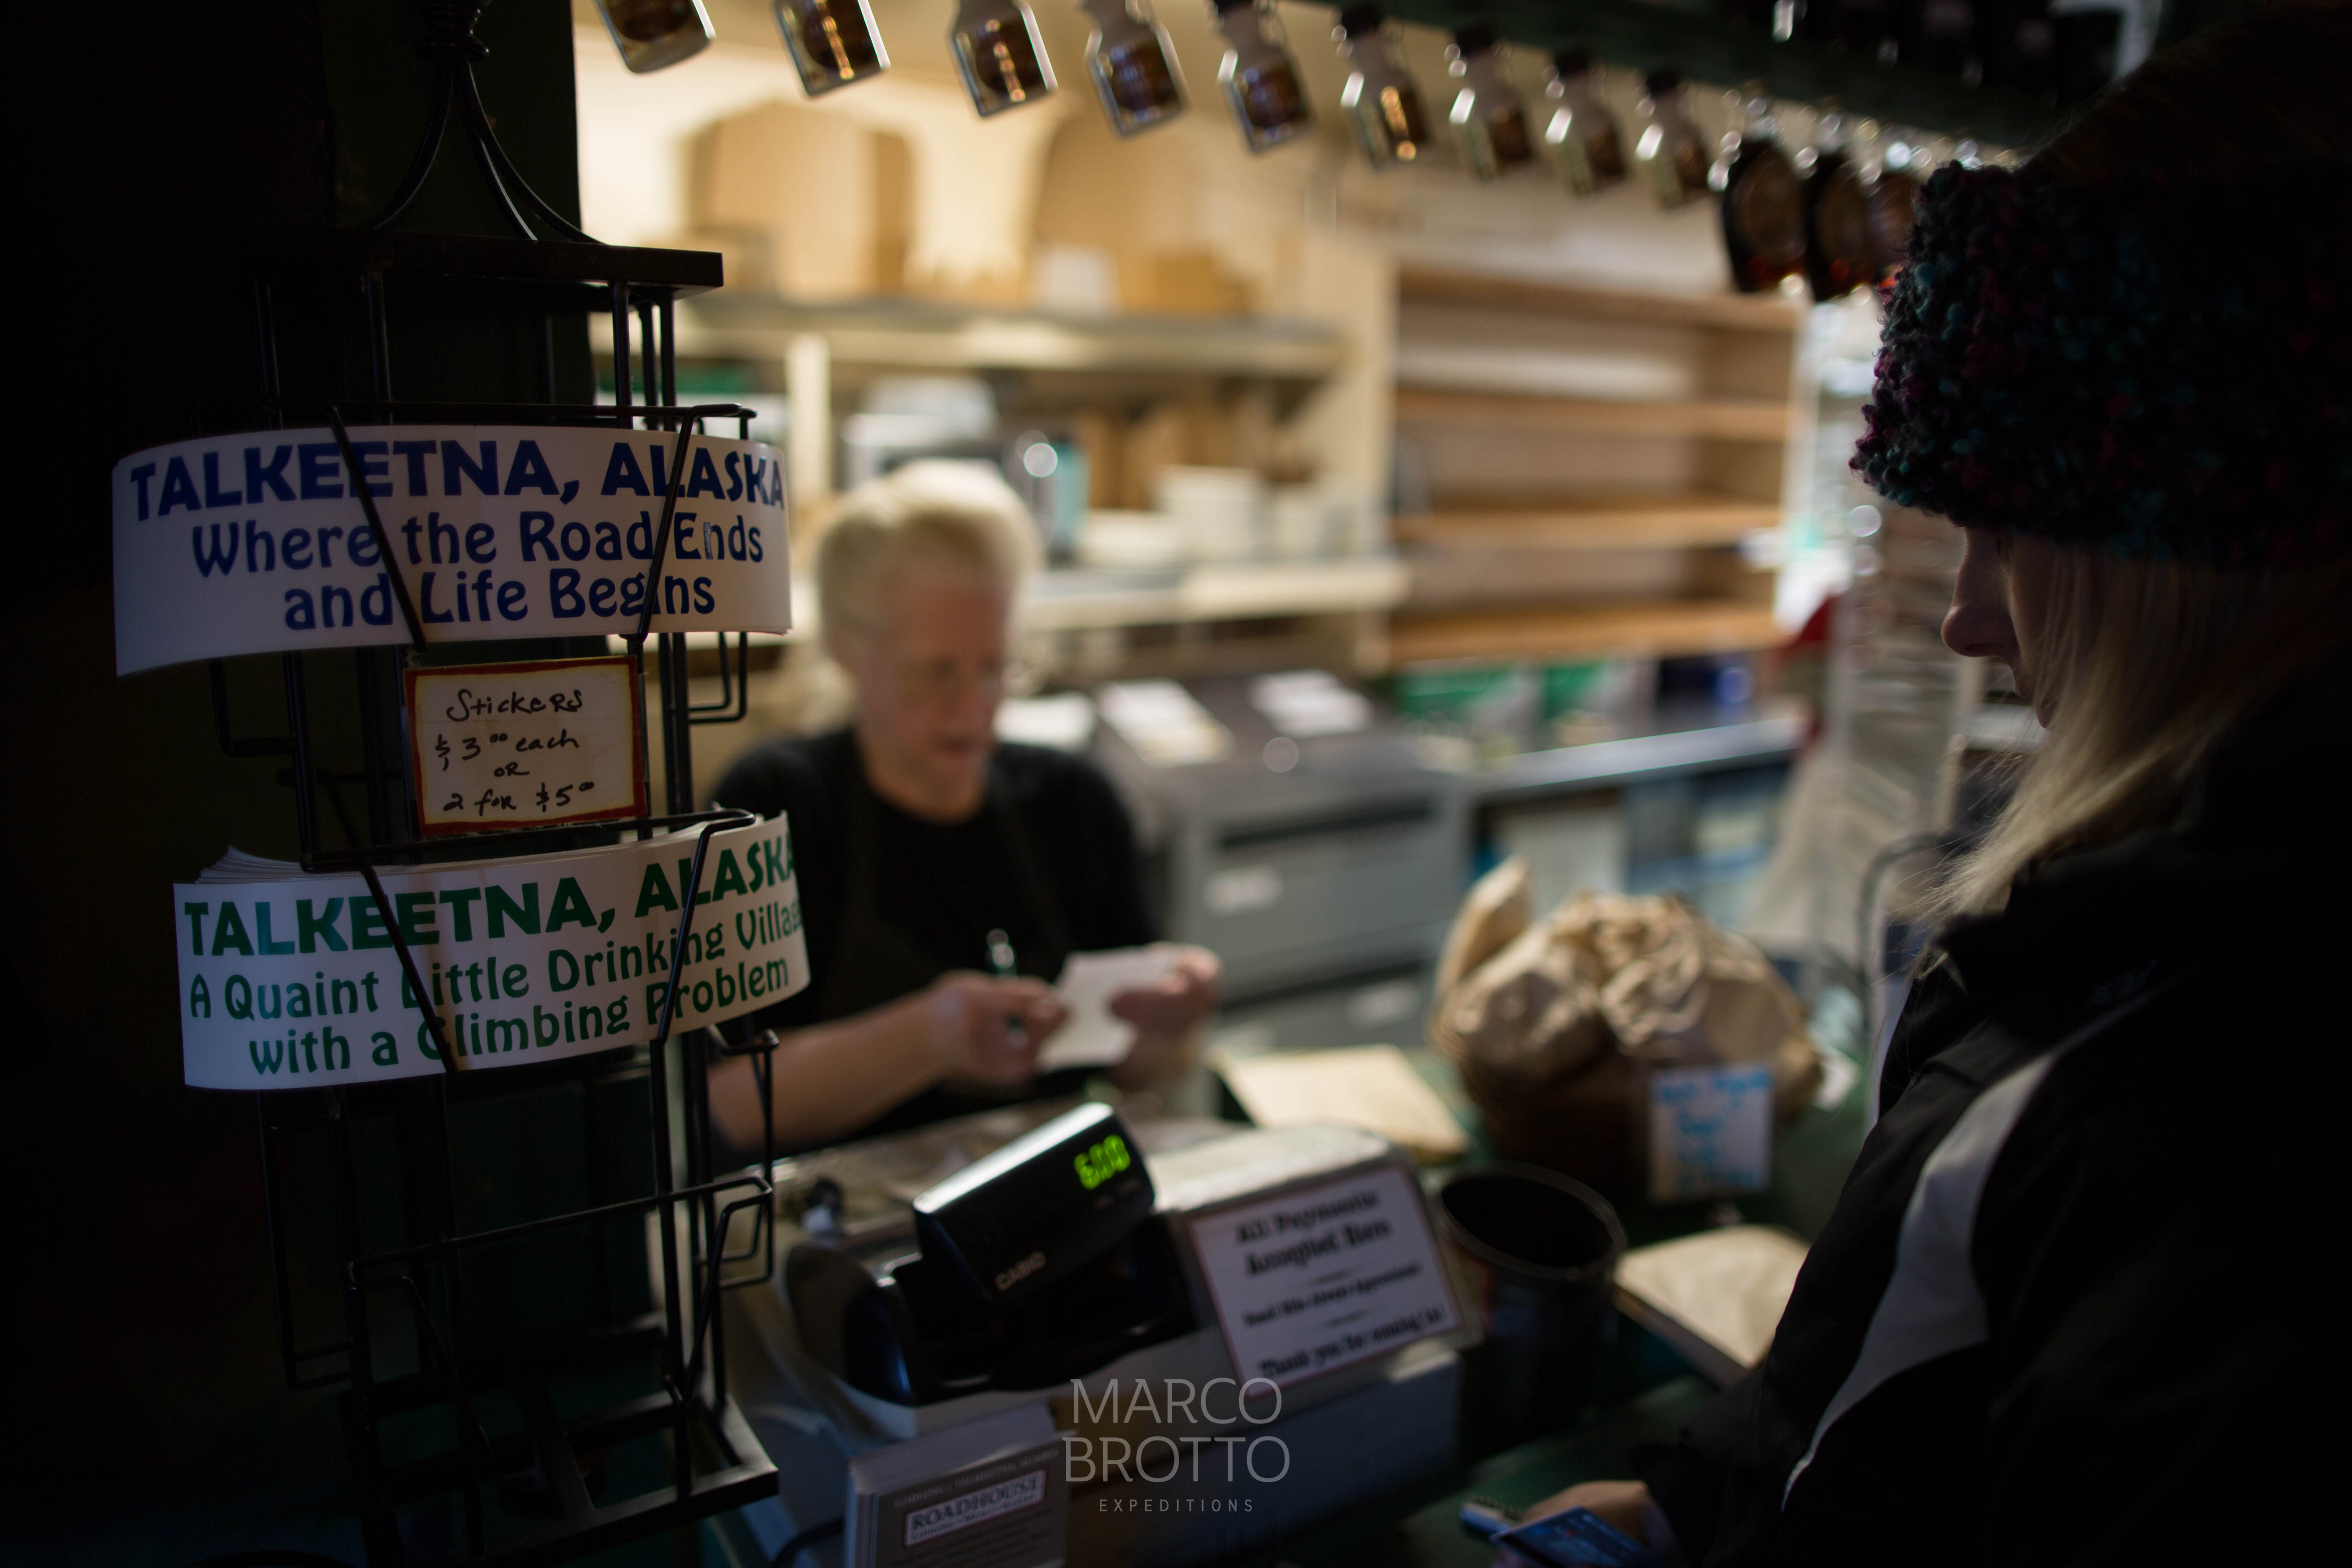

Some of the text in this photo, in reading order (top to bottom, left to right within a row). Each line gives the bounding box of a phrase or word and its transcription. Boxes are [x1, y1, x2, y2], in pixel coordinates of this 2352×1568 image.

[130, 440, 784, 521] TALKEETNA, ALASKA
[192, 510, 763, 578] Where the Road Ends
[285, 572, 394, 630] and
[421, 569, 528, 624] Life
[516, 729, 579, 751] each
[443, 793, 463, 811] 2
[184, 877, 615, 956] TALKEETNA,
[190, 900, 804, 1021] A Quaint Little Drinking Villag
[249, 958, 788, 1075] with a Climbing Problem
